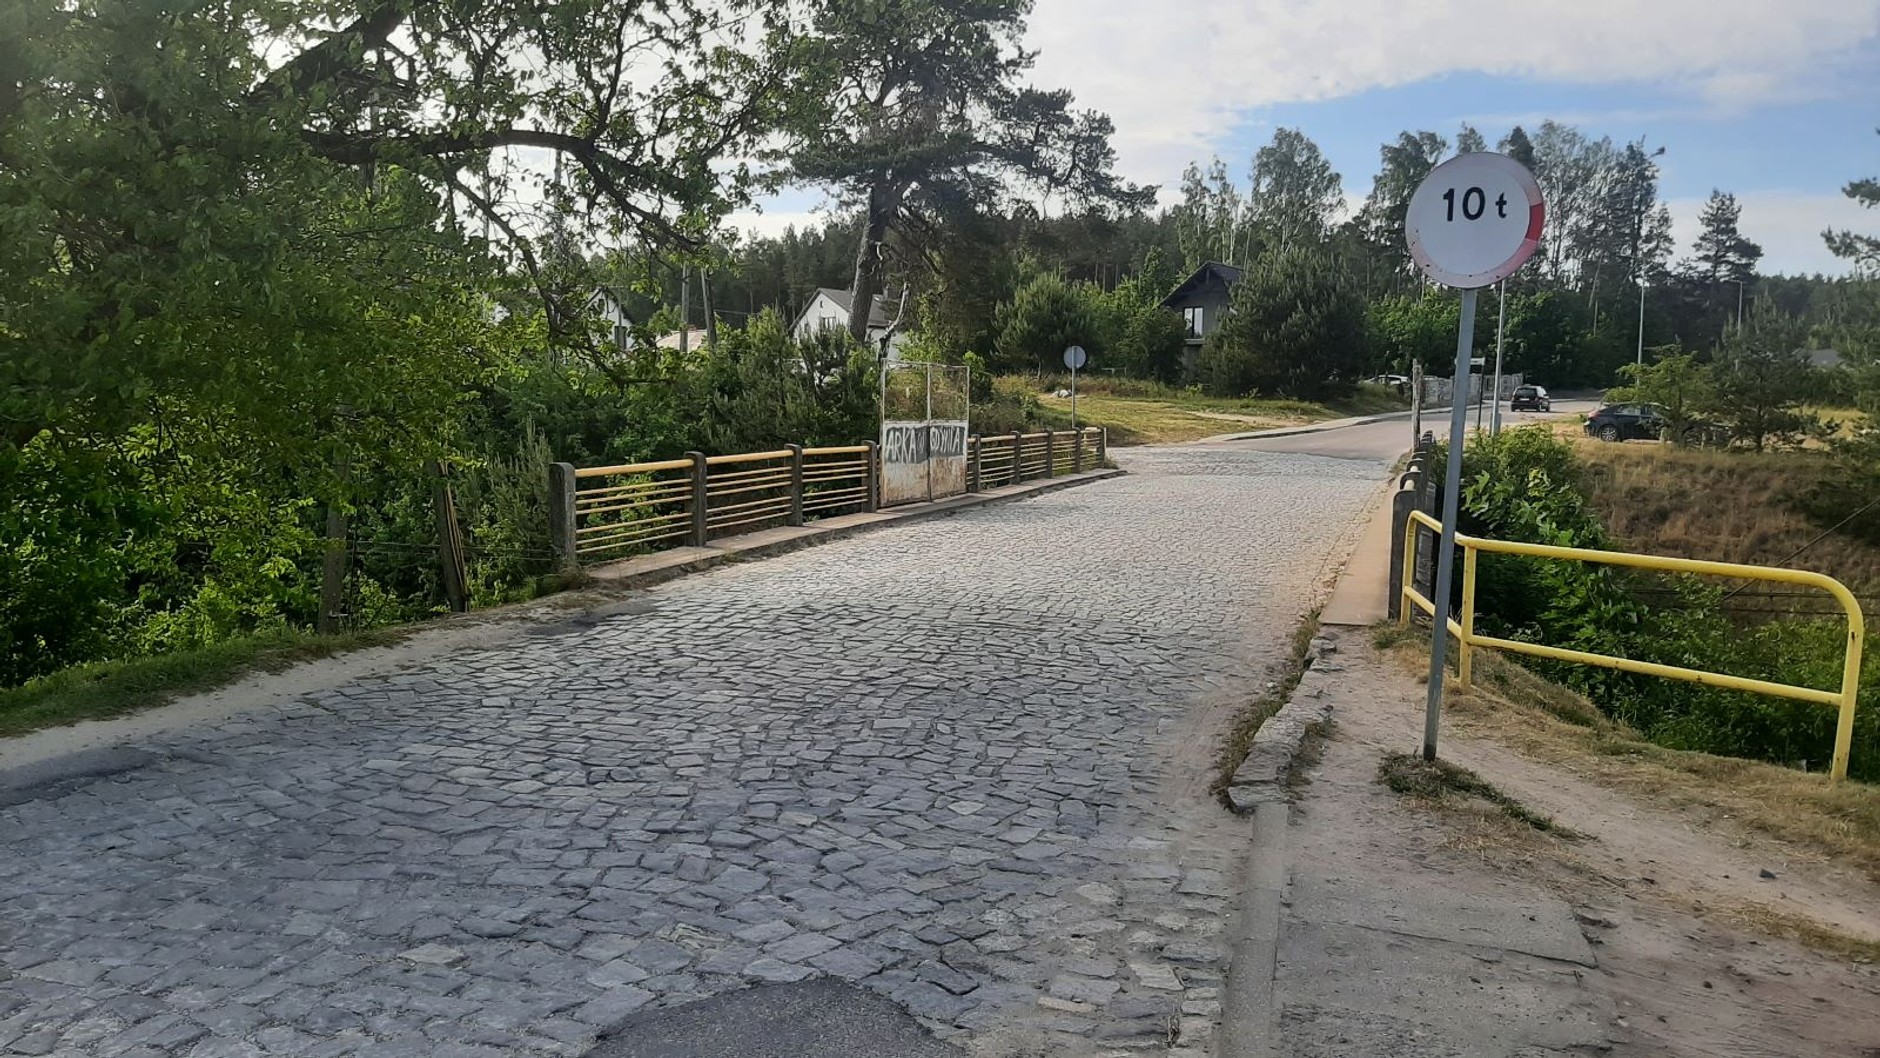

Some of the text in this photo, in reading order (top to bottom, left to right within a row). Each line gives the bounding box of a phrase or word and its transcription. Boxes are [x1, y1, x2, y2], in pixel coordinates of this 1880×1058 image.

[1442, 186, 1508, 222] 10 t
[885, 426, 917, 464] ARKA
